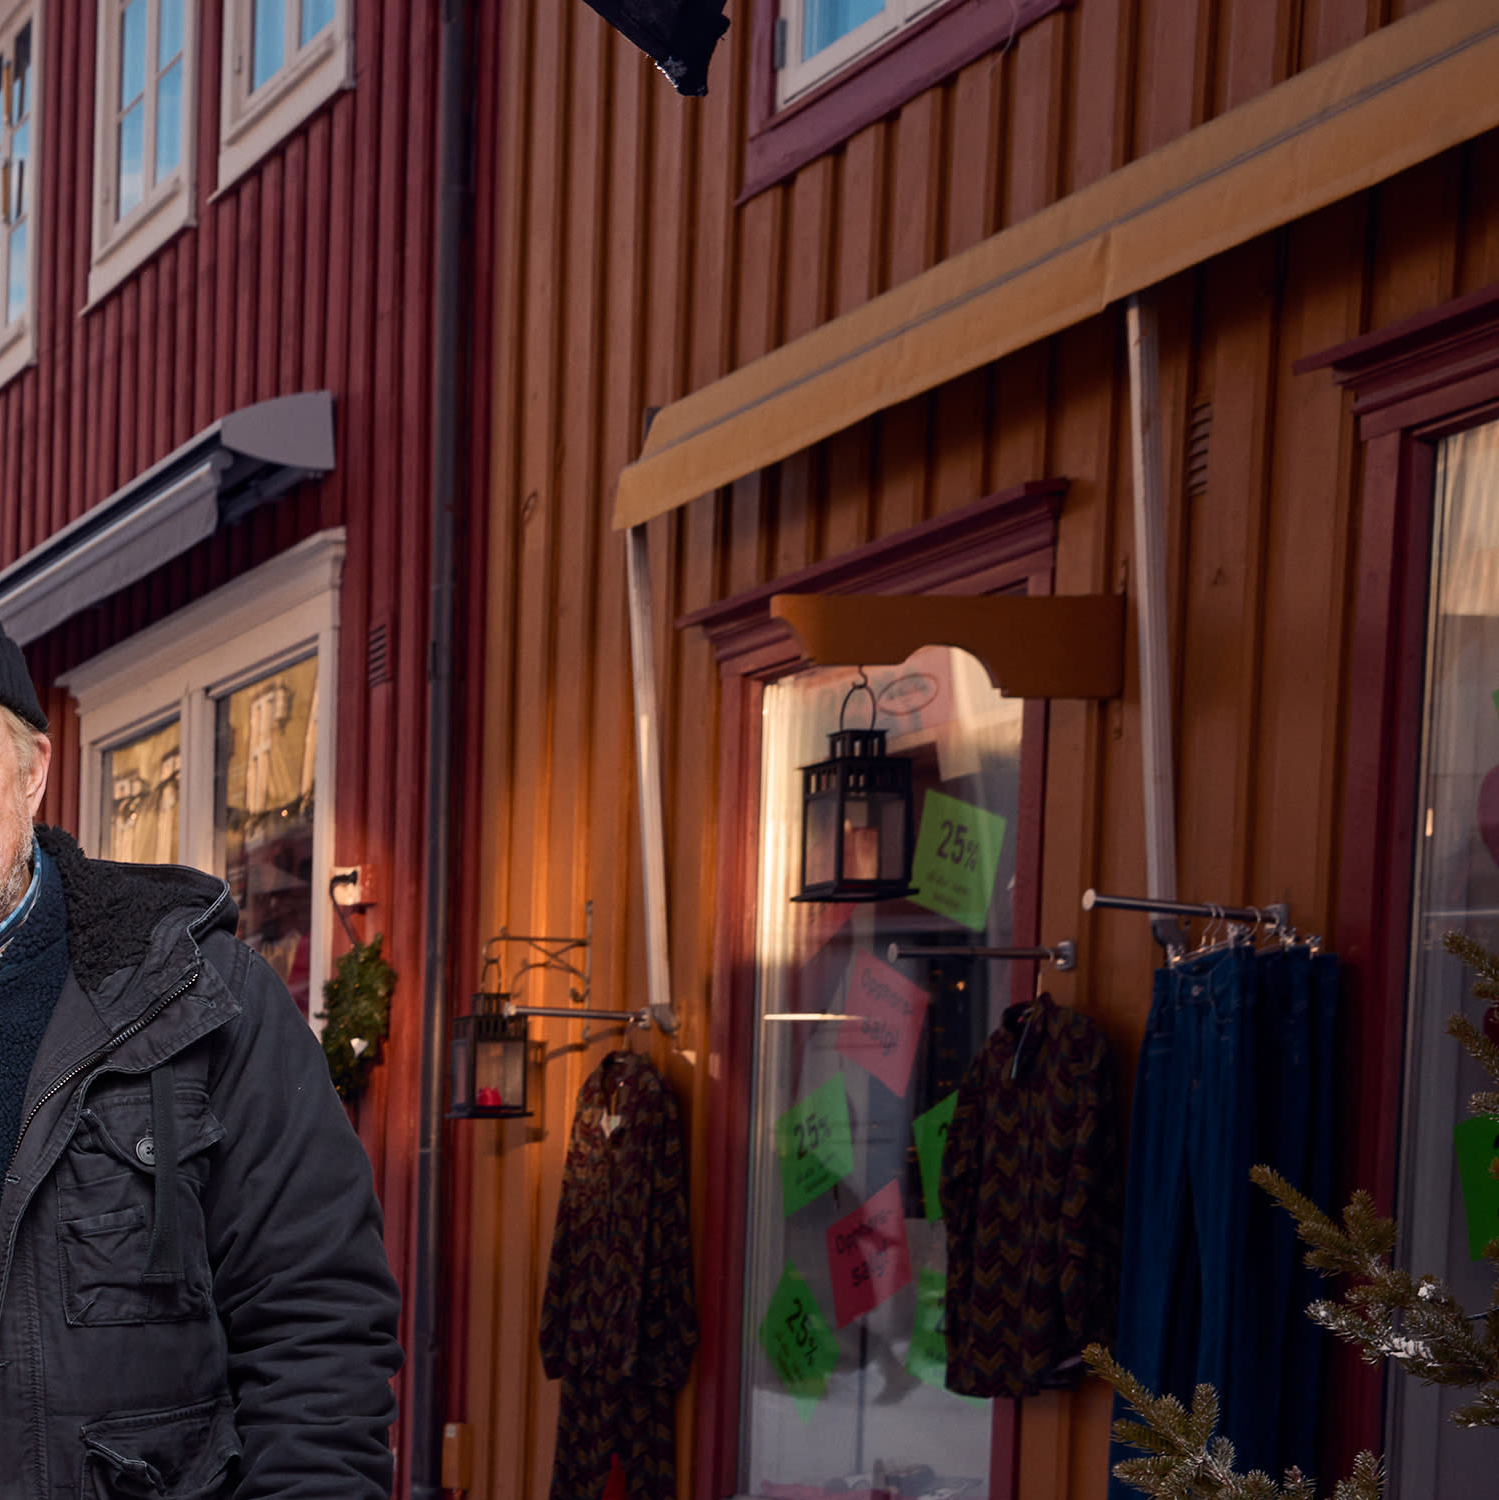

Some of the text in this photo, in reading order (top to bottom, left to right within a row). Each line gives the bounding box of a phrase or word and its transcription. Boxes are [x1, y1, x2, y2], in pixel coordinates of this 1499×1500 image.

[937, 820, 978, 872] 25%
[794, 1113, 831, 1160] 25%
[784, 1297, 818, 1368] 25%
